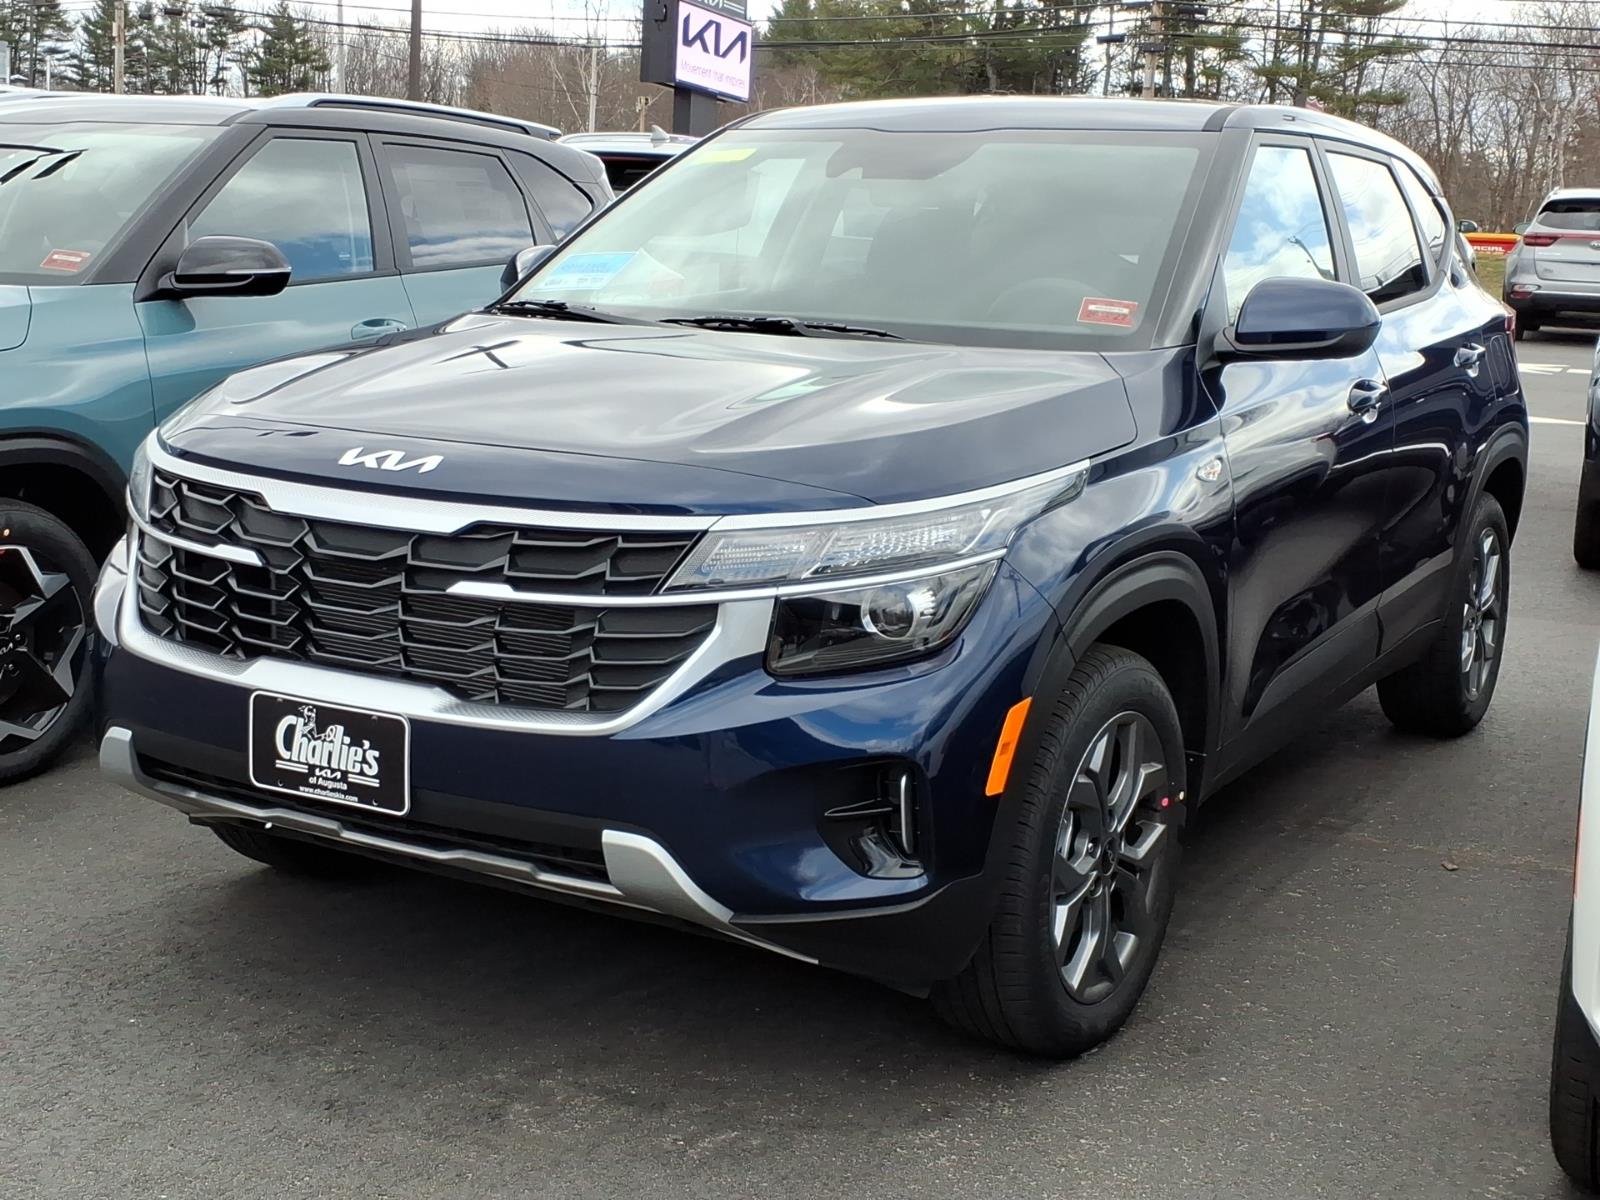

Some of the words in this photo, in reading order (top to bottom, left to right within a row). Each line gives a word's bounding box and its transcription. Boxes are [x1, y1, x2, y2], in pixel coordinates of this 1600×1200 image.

[682, 12, 747, 64] KIA
[337, 446, 444, 474] KIA
[275, 715, 380, 776] Charlie's
[308, 776, 317, 784] of
[317, 777, 348, 790] Augusta
[315, 767, 341, 779] KIA
[299, 785, 358, 802] www.charlieskia.com
